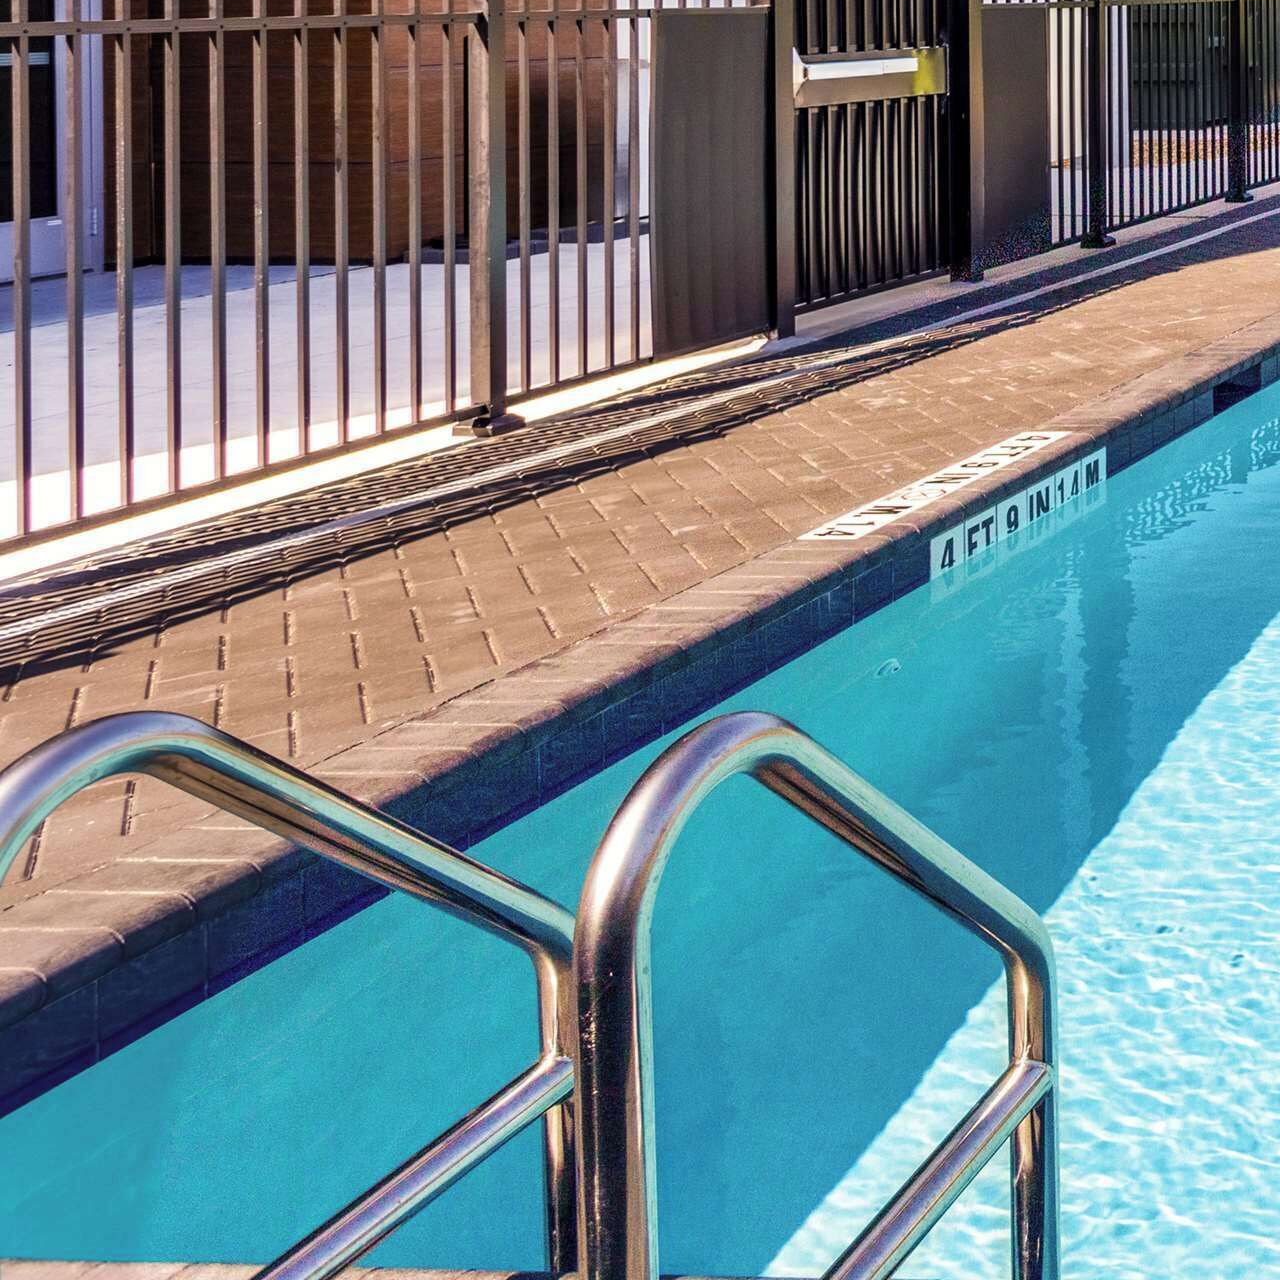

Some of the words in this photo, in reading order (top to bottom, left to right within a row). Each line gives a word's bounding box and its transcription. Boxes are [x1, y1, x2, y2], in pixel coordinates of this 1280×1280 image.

[941, 537, 956, 570] 4
[1006, 504, 1019, 535] 9
[1058, 469, 1079, 504] 1.4
